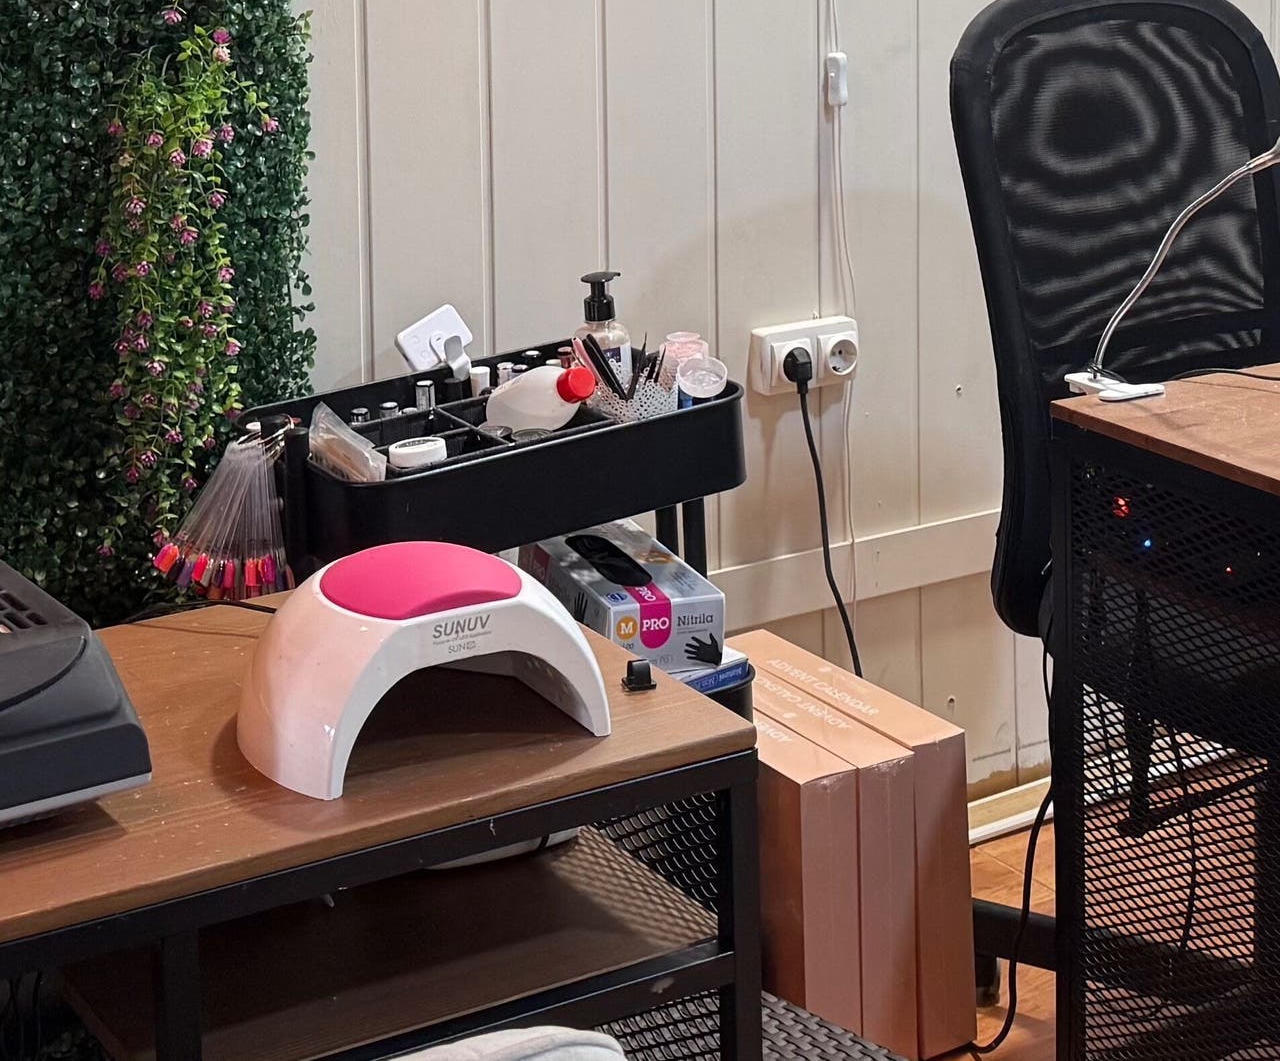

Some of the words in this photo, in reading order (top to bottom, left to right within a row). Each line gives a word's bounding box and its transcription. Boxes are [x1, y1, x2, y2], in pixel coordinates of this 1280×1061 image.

[433, 614, 491, 639] SUNUV
[620, 621, 634, 635] M
[642, 617, 669, 632] PRO
